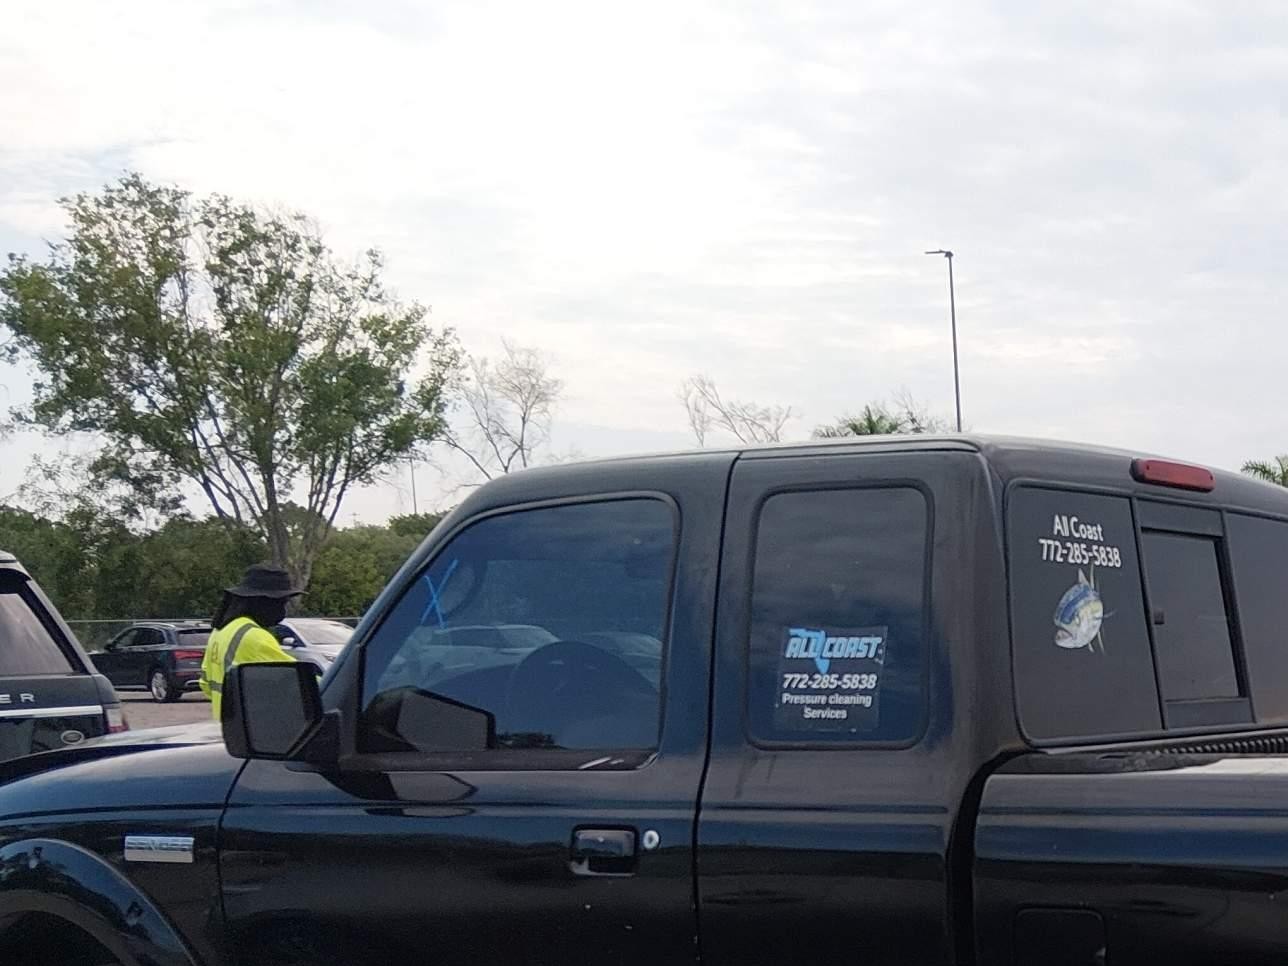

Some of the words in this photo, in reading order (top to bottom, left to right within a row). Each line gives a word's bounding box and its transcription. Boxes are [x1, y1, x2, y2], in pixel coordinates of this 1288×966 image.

[1053, 514, 1070, 537] All
[1070, 516, 1104, 542] Coast
[1038, 538, 1122, 568] 772-285-5838
[785, 636, 821, 659] ALL
[822, 636, 883, 659] COAST
[782, 673, 878, 689] 772-285-5838
[782, 692, 828, 705] Pressure
[828, 692, 873, 708] cleaning
[803, 706, 848, 719] Services
